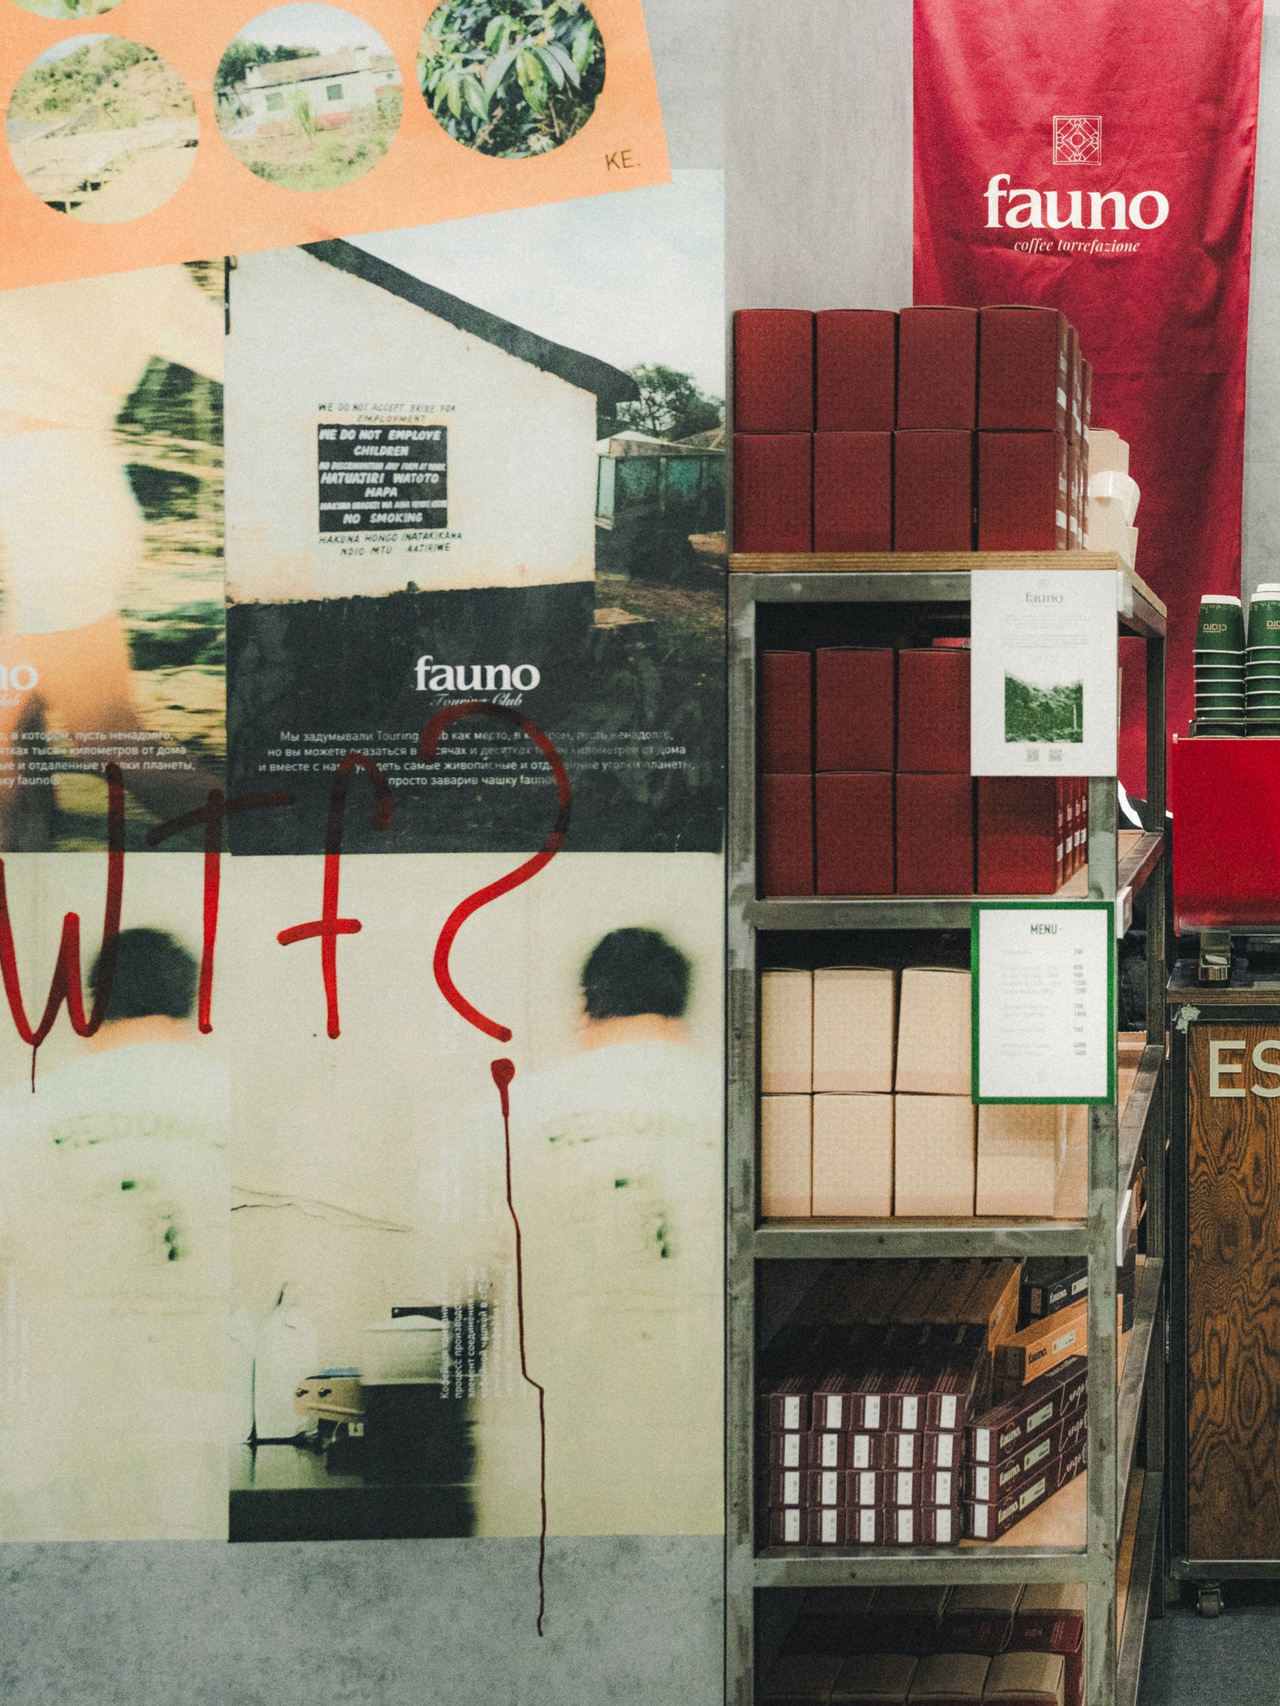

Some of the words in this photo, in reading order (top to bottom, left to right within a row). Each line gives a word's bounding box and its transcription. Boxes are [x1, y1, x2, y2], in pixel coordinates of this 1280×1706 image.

[983, 173, 1170, 230] fauno
[1014, 238, 1053, 253] coffee
[1057, 238, 1140, 254] torrefazione
[318, 429, 338, 441] WE
[339, 429, 356, 441] DO
[359, 429, 382, 441] NOT
[388, 430, 442, 441] EMPLOYE
[353, 445, 410, 456] CHILDREN
[393, 472, 440, 485] WATOTO
[364, 487, 398, 498] HAPA
[342, 513, 361, 525] NO
[369, 512, 423, 524] SMOKING
[1025, 592, 1064, 604] fauno
[414, 655, 541, 691] fauno
[280, 731, 299, 741] Мы
[303, 732, 373, 743] задумывали
[377, 731, 419, 742] Touring
[452, 733, 471, 741] как
[143, 747, 153, 756] от
[267, 748, 282, 757] но
[285, 748, 301, 757] вы
[304, 748, 346, 757] можете
[259, 763, 266, 772] и
[269, 763, 310, 772] вместе
[313, 763, 320, 771] с
[404, 762, 440, 771] самые
[388, 777, 427, 788] просто
[430, 777, 478, 787] заварив
[481, 776, 517, 788] чашку
[1030, 924, 1058, 935] MENU
